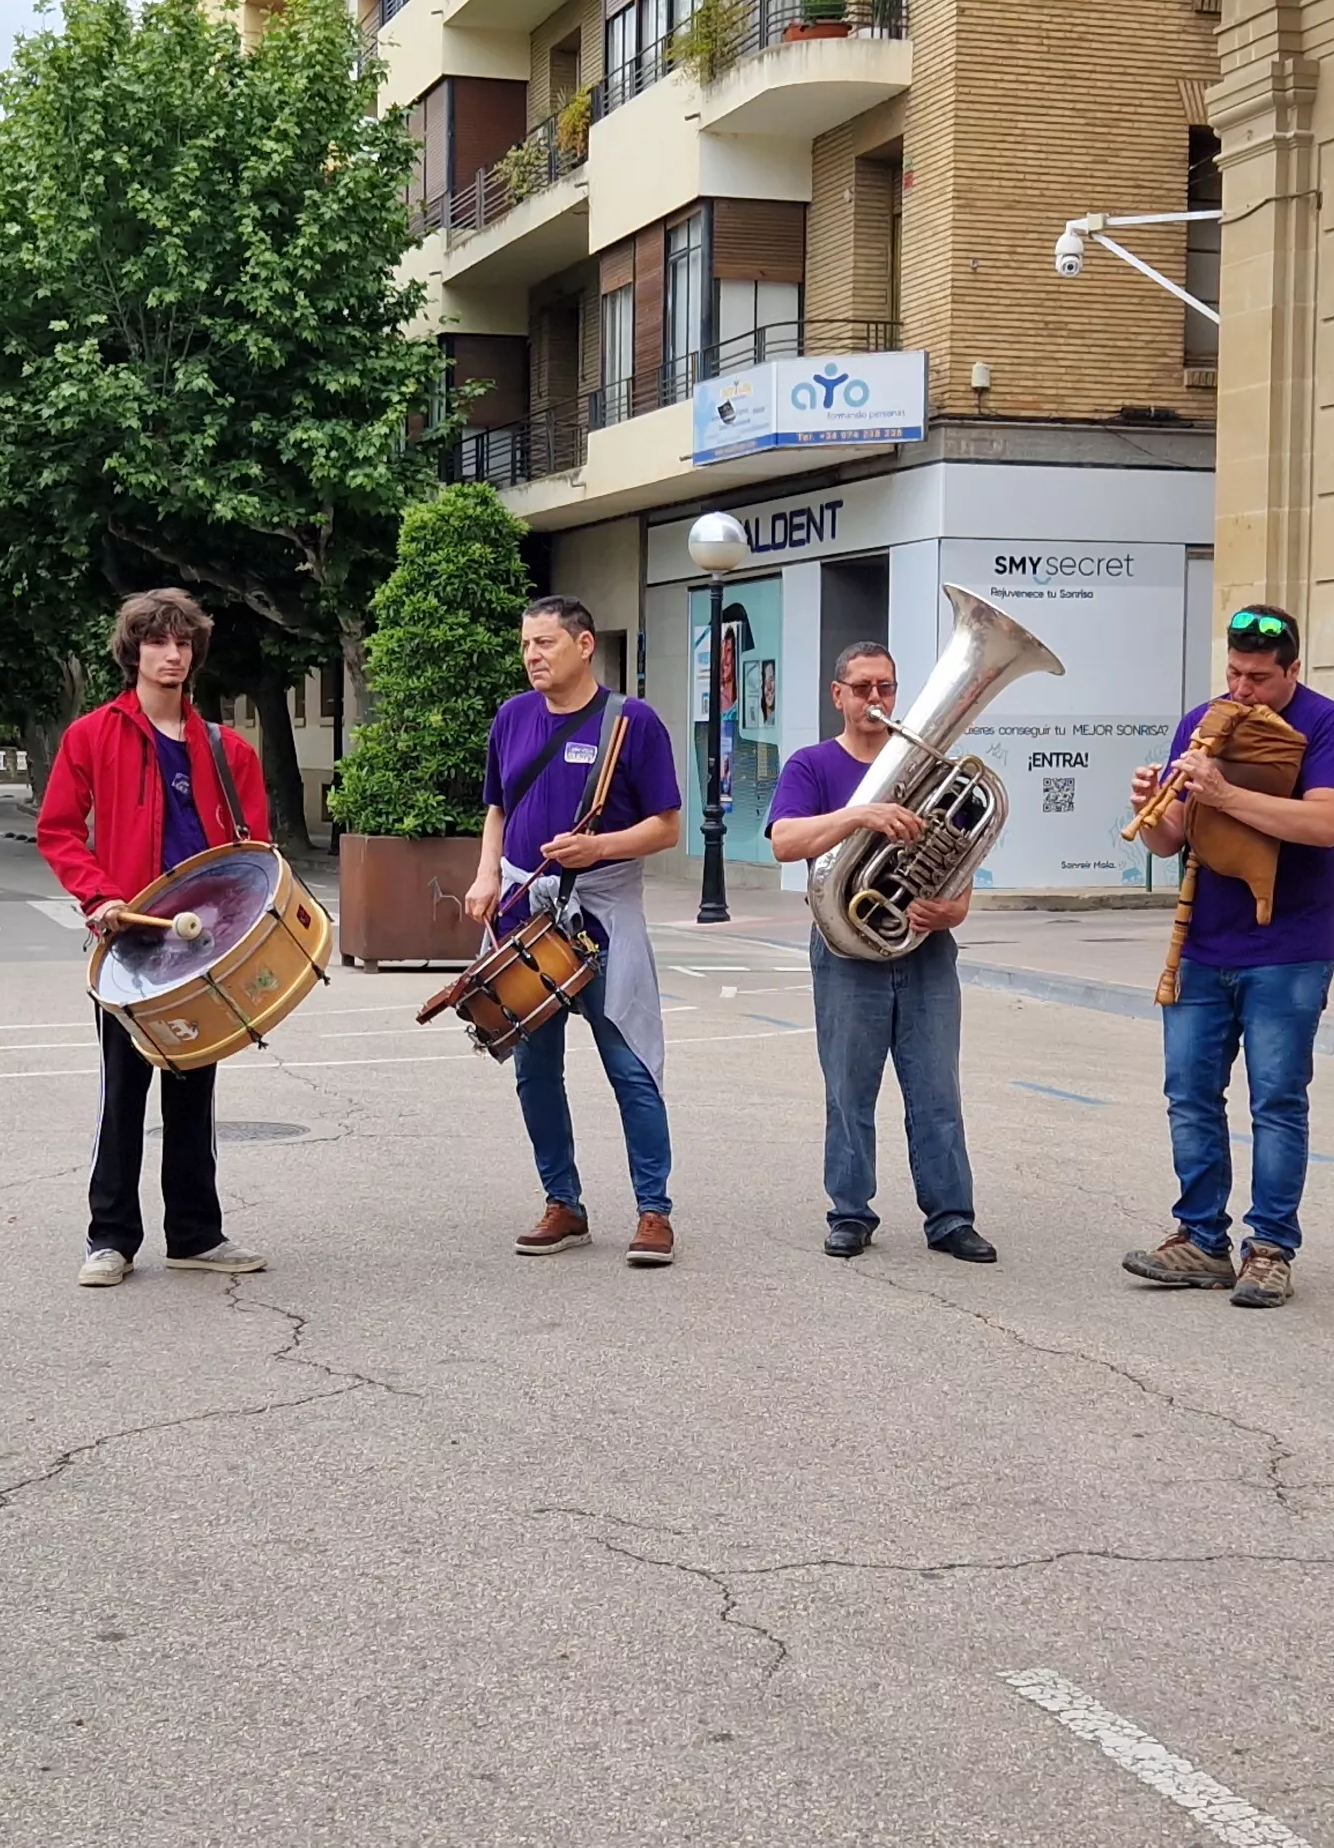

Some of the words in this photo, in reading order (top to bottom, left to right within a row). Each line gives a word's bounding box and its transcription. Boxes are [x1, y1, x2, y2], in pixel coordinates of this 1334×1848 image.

[990, 587, 1044, 600] Rejuvenece
[1047, 589, 1057, 599] tu
[1059, 588, 1094, 599] Sonrisa
[998, 724, 1051, 739] conseguir
[1055, 725, 1066, 736] tu
[1072, 724, 1113, 736] MEJOR
[1116, 724, 1169, 736] SONRISA?
[1028, 752, 1089, 772] ¡ENTRA!
